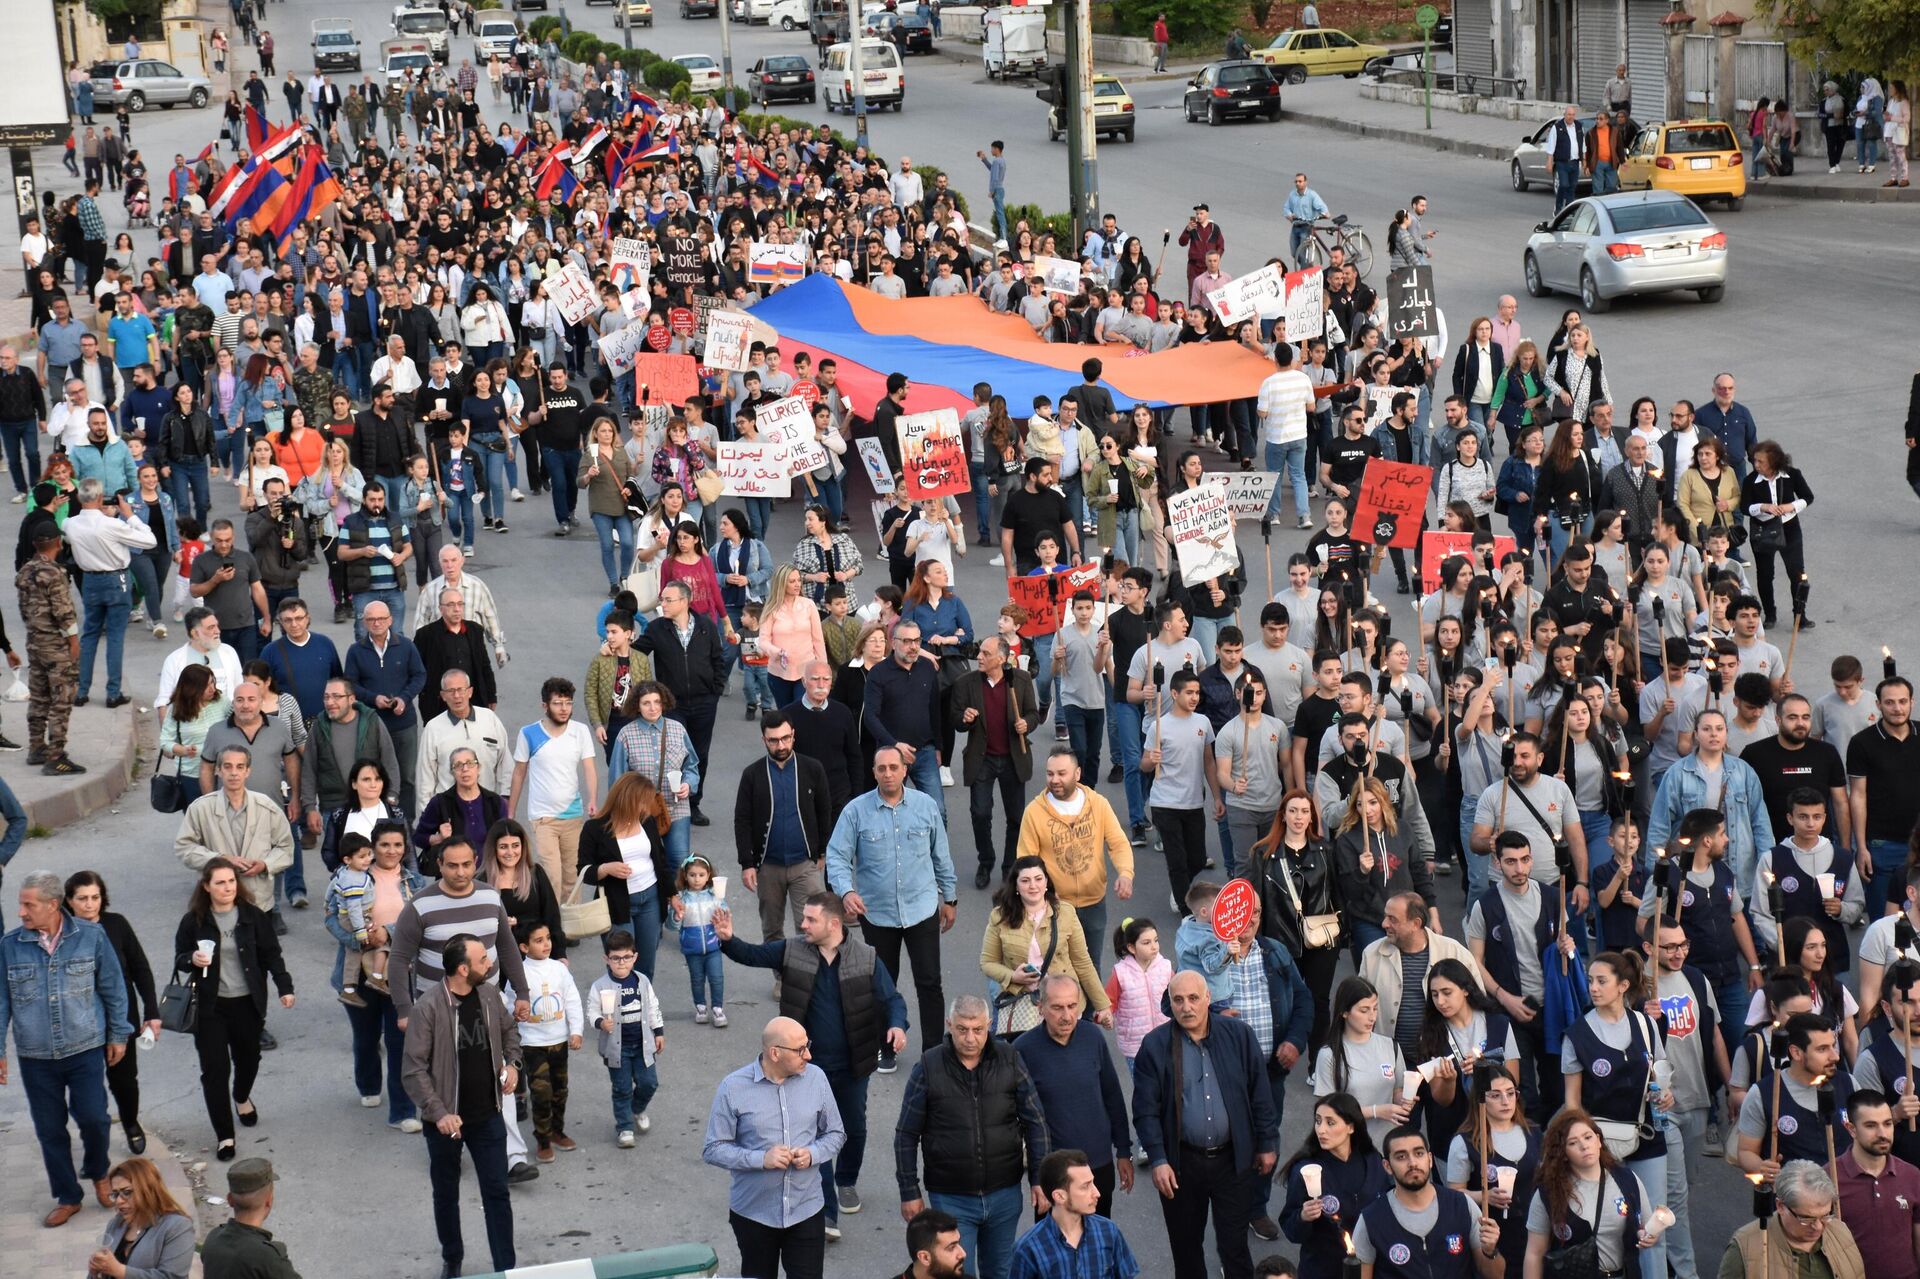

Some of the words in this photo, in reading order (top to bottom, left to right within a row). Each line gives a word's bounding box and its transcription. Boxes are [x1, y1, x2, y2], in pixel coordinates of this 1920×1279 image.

[676, 238, 694, 252] NO
[614, 247, 648, 261] SEPERATE
[670, 254, 702, 268] MORE
[640, 262, 650, 271] US
[1394, 310, 1427, 332] أخرى
[546, 400, 578, 409] SQUAD
[758, 398, 806, 426] TURKEY
[782, 424, 798, 440] IS
[720, 448, 762, 462] يموت
[774, 448, 788, 462] لن
[793, 450, 827, 472] OBLEM
[1240, 476, 1263, 486] TO
[1174, 498, 1190, 510] WE
[1190, 490, 1214, 504] WILL
[1172, 506, 1195, 524] NOT
[1197, 494, 1226, 513] ALLOW
[1174, 520, 1190, 532] TO
[1192, 506, 1227, 525] HAPPEN
[1176, 526, 1205, 544] GENOCIDE
[1208, 518, 1229, 533] AGAIN
[1226, 896, 1240, 908] 1915
